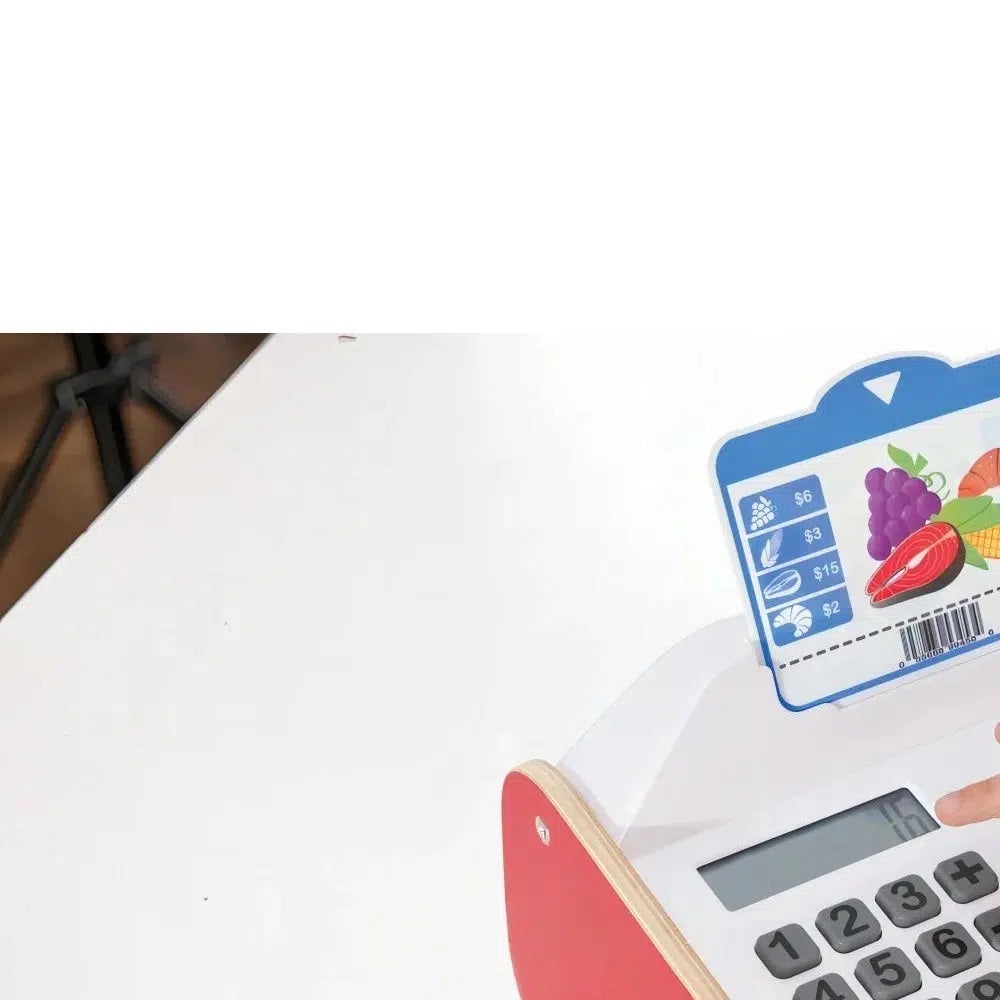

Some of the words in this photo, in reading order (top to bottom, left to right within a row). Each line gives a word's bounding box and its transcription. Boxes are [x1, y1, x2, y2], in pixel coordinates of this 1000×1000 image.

[794, 489, 812, 507] $6
[804, 527, 821, 544] $3
[814, 561, 839, 581] $15
[823, 600, 840, 619] $2
[769, 931, 799, 960] 1
[830, 904, 870, 937] 2
[891, 880, 927, 910] 3
[870, 952, 906, 986] 5
[932, 928, 968, 959] 6
